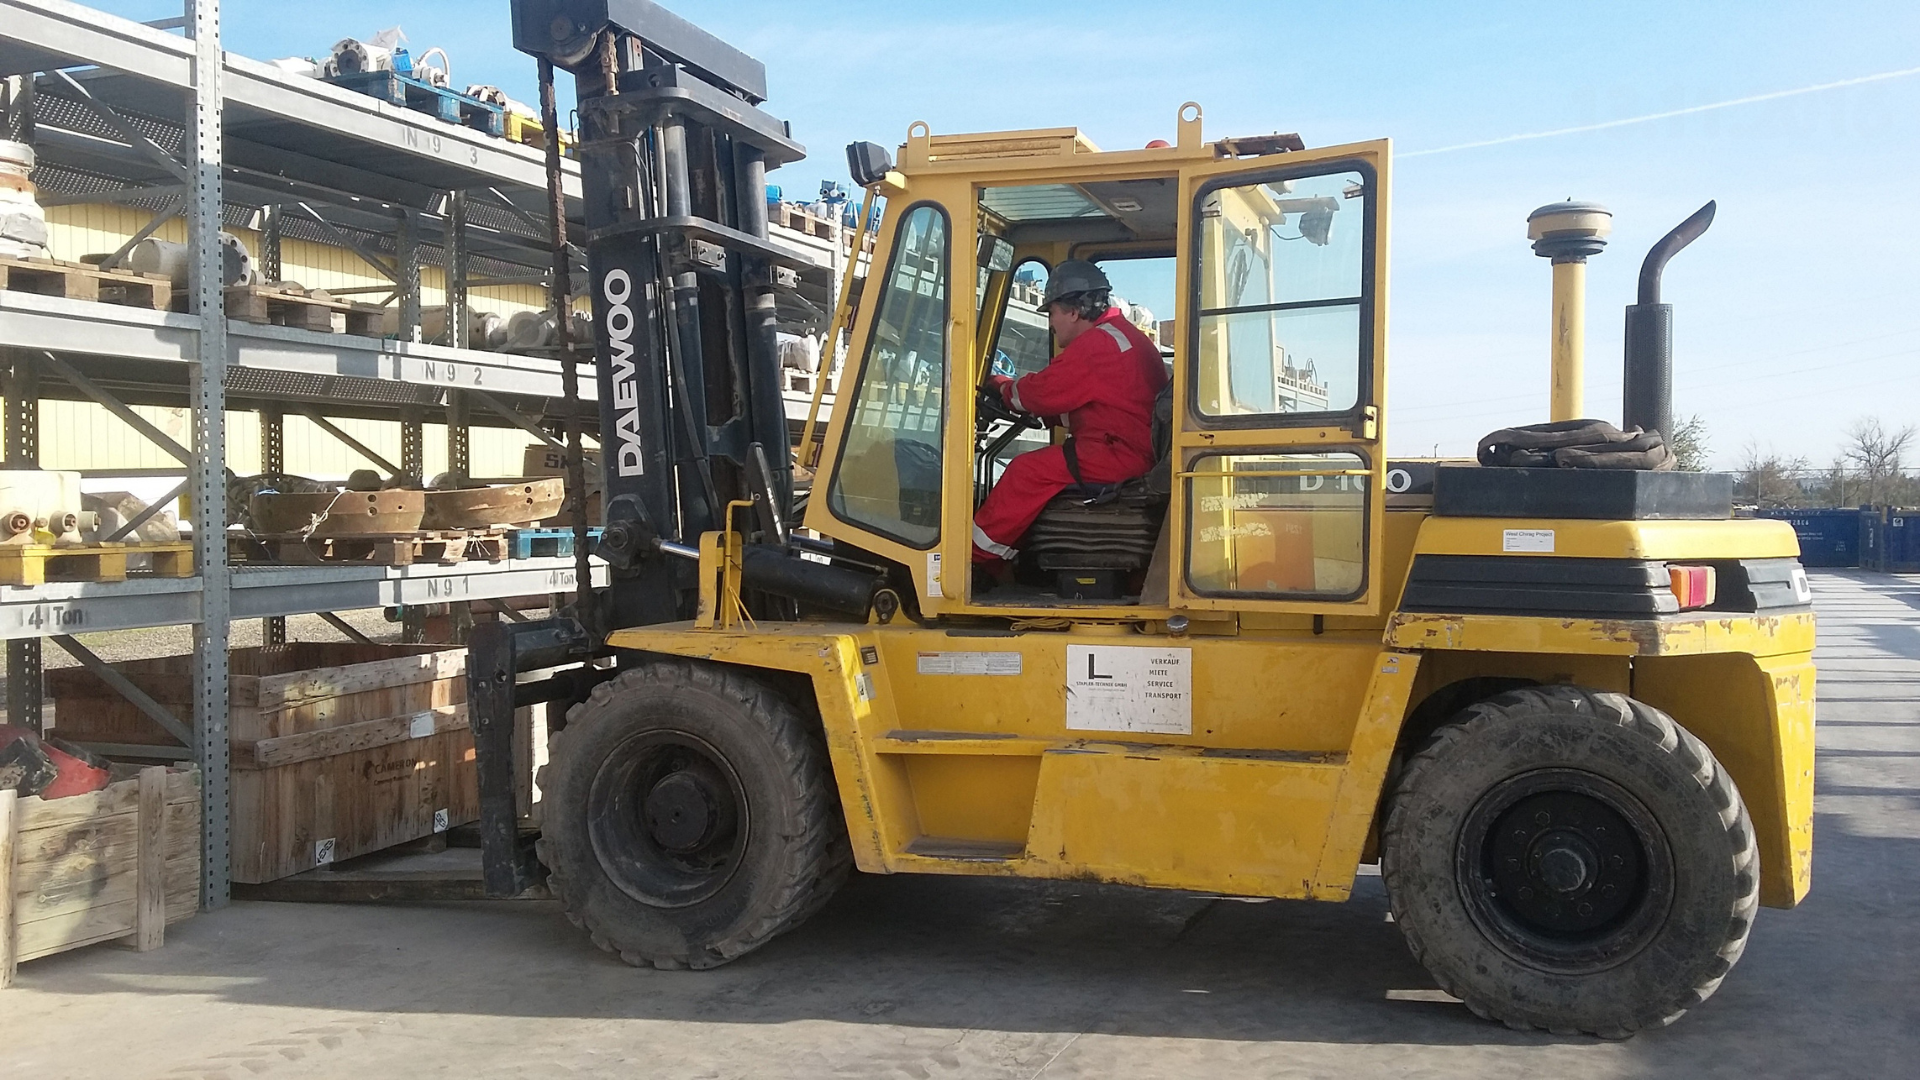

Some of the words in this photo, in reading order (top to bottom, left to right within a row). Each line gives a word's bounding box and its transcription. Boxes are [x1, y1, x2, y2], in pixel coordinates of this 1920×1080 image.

[407, 127, 418, 148] N
[432, 135, 442, 154] 9
[469, 147, 478, 165] 3
[425, 361, 436, 381] N
[447, 363, 456, 382] 9
[473, 366, 483, 386] 2
[603, 268, 644, 477] DAEWOO
[427, 578, 438, 598] N
[443, 578, 453, 596] 9
[462, 575, 469, 594] 1
[559, 571, 574, 585] Ton
[28, 604, 43, 630] 4
[53, 605, 83, 626] Ton
[1088, 653, 1113, 679] L
[1147, 680, 1173, 688] SERVICE
[375, 758, 417, 774] CAMERON
